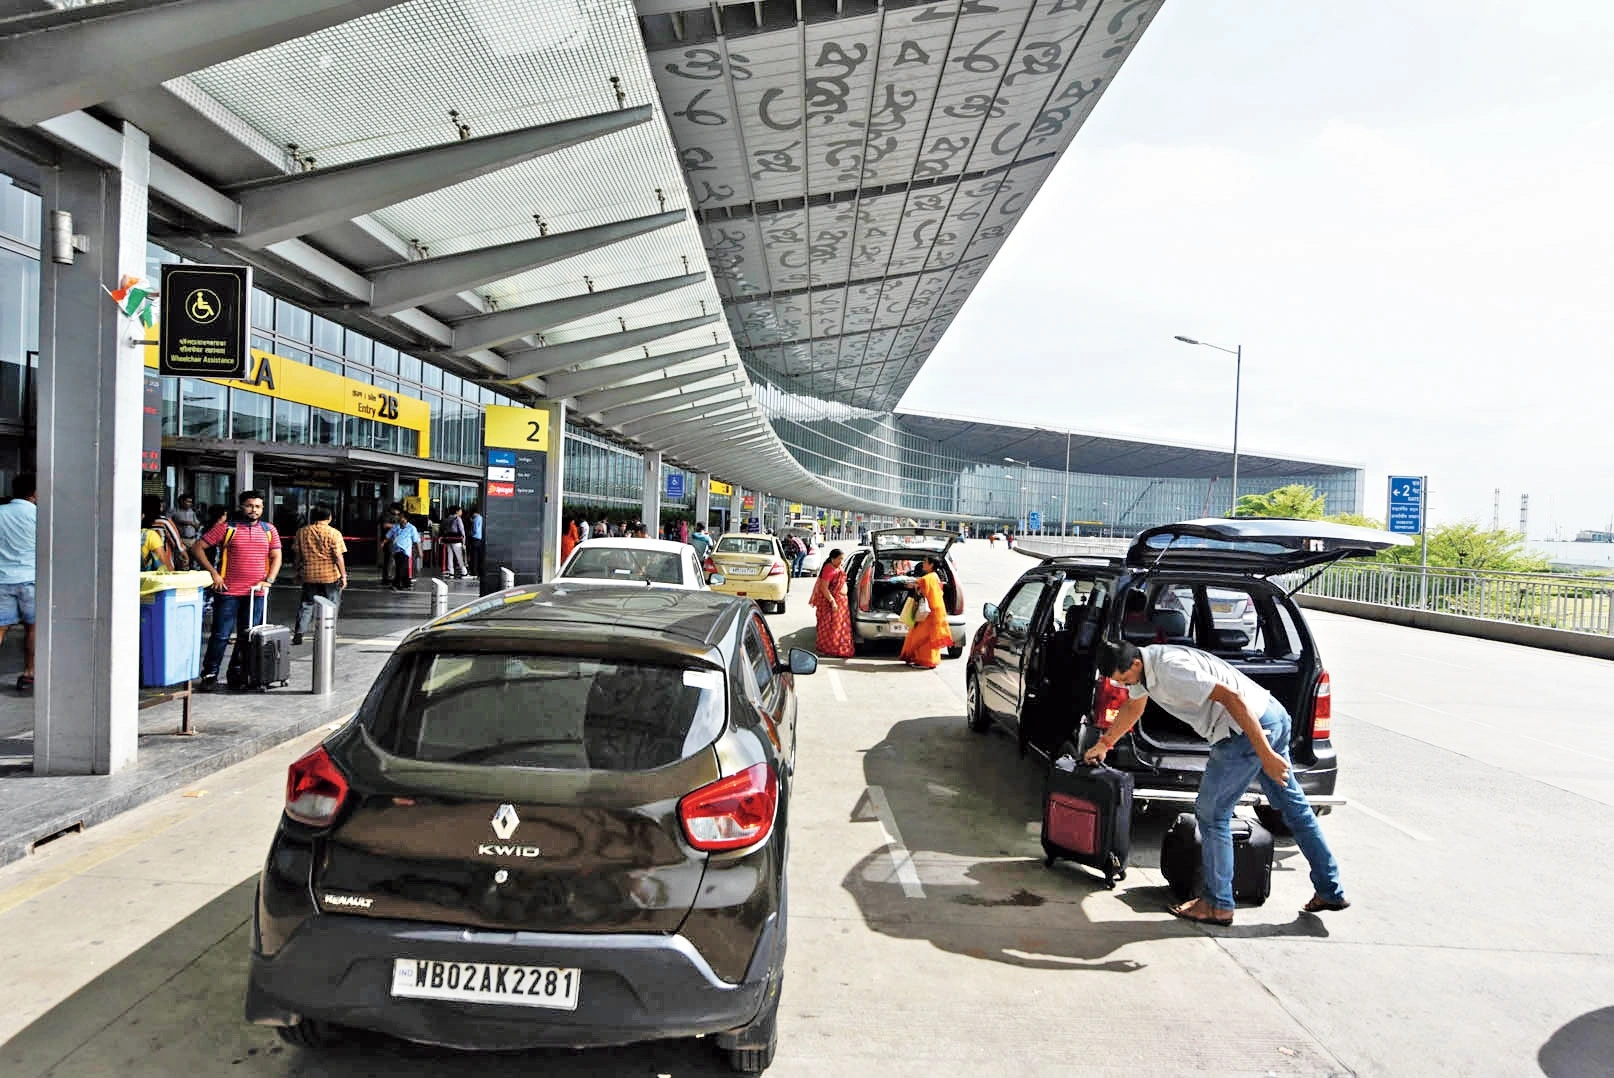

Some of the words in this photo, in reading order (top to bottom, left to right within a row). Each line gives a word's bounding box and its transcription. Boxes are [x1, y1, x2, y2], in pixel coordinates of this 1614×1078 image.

[170, 354, 202, 363] Wheelchair
[202, 356, 235, 364] Assistance
[357, 402, 377, 418] Entry
[378, 392, 399, 420] 2B
[526, 420, 541, 442] 2
[1402, 484, 1410, 497] 2
[478, 844, 540, 857] KWID
[324, 894, 373, 908] RENAULT
[415, 960, 573, 998] WB02AK2281
